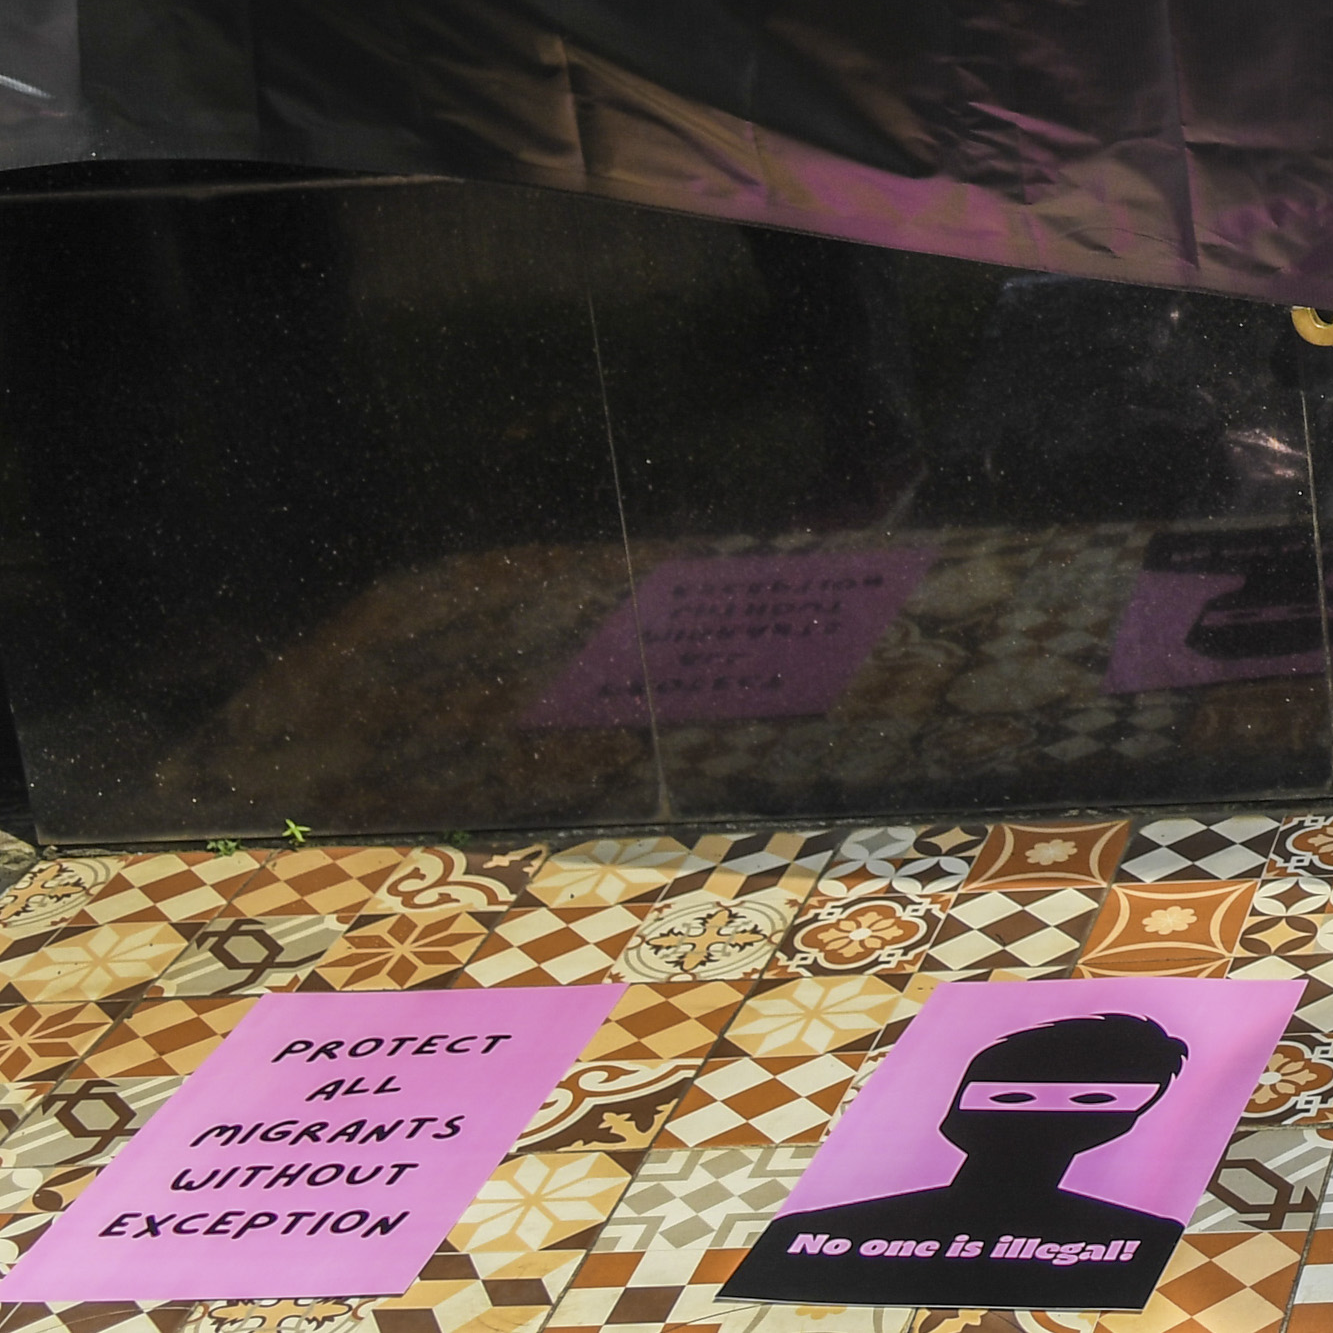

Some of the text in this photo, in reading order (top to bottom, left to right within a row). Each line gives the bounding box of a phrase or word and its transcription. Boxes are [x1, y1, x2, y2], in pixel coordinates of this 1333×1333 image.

[271, 1034, 513, 1063] PROTECT
[305, 1075, 402, 1102] ALL
[190, 1115, 465, 1147] MIGRANTS
[170, 1162, 419, 1191] WITHOUT
[98, 1210, 410, 1240] EXCEPTION
[786, 1233, 1141, 1266] No one is illegal!
